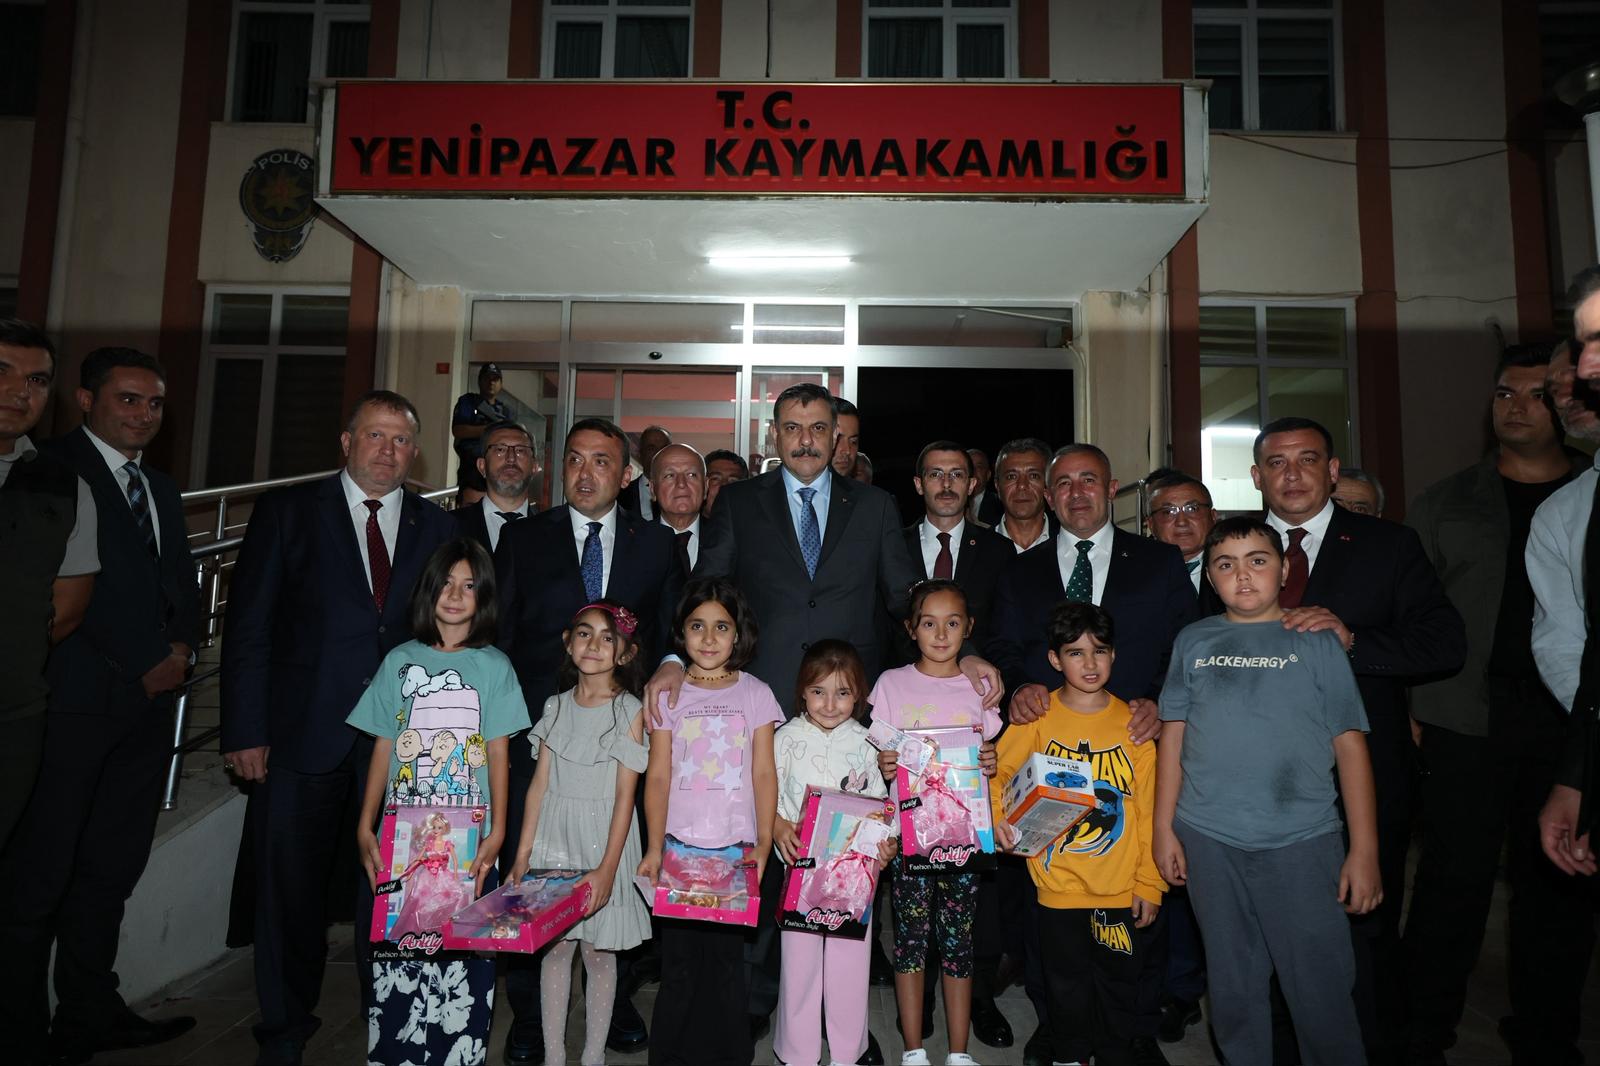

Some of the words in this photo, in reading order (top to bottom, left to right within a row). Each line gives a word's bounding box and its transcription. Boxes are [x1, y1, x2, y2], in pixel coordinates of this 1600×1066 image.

[716, 91, 810, 129] T.C.
[350, 123, 676, 176] YENİPAZAR
[704, 124, 1168, 179] KAYMAKAMLIĞI
